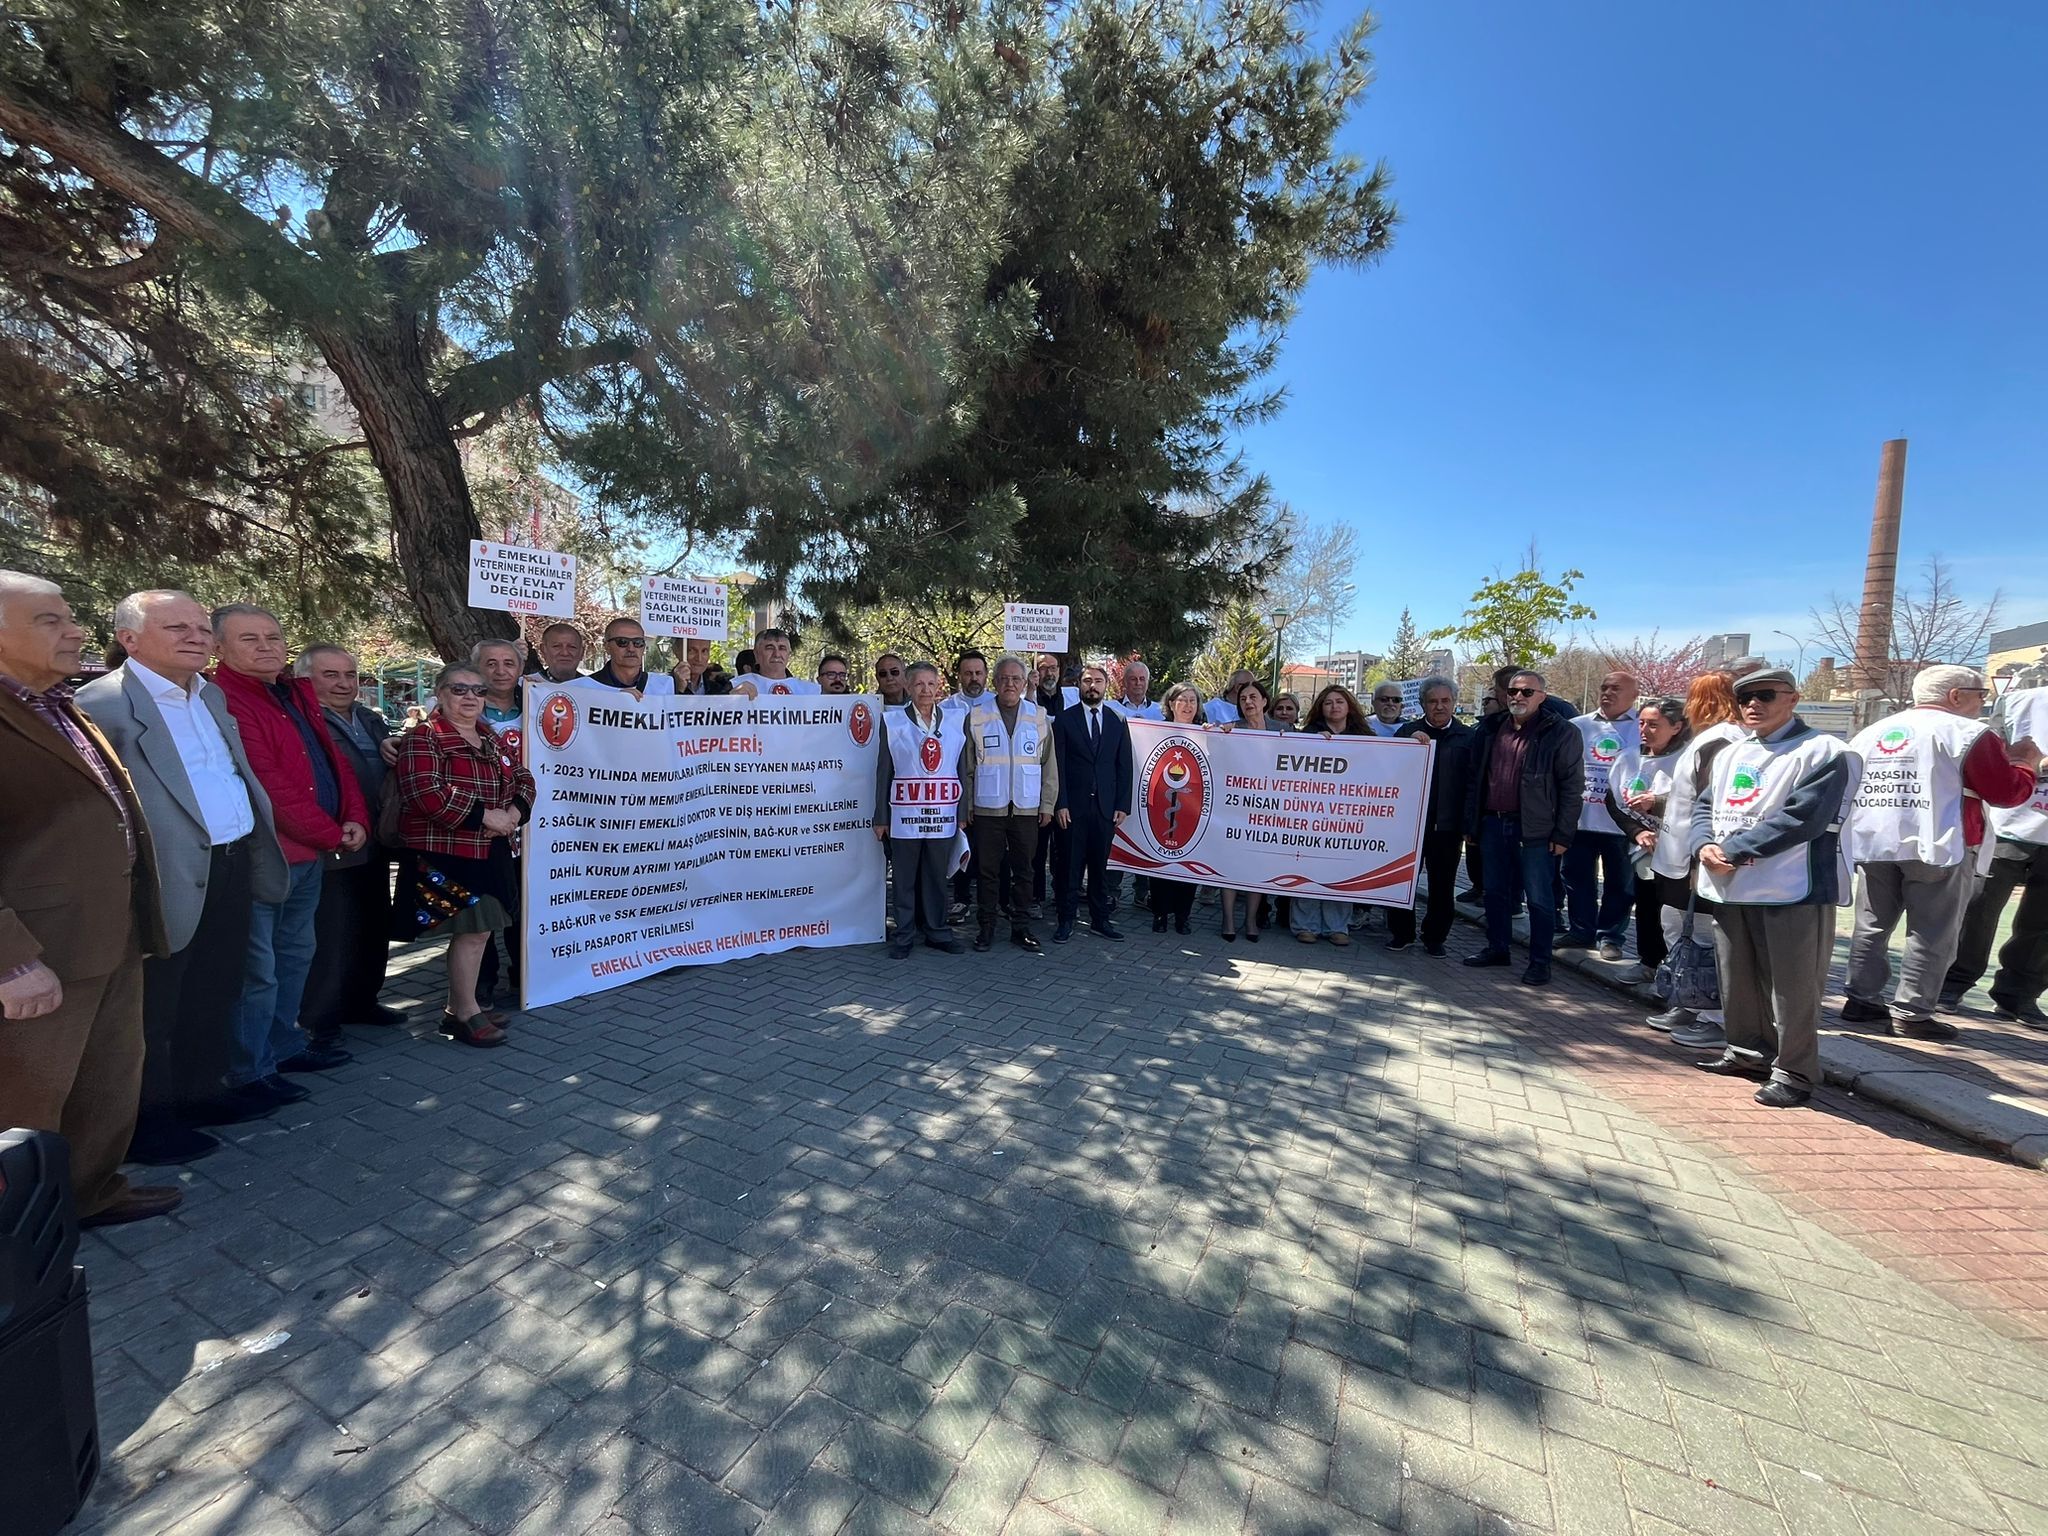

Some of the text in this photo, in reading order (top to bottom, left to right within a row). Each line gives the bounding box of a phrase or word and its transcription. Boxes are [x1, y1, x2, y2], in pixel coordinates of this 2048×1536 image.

[499, 550, 550, 565] EMEKLİ
[474, 558, 572, 580] VETERİNER HEKİMLER
[480, 570, 565, 590] ÜVEY EVLAT
[664, 582, 706, 594] EMEKLİ
[490, 585, 554, 601] DEĞİLDİR
[644, 591, 724, 607] VETERİNER HEKİMLER
[508, 600, 537, 610] EVHED
[646, 602, 724, 617] SAĞLIK SINIFI
[649, 613, 721, 627] EMEKLİSİDİR
[673, 626, 697, 635] EVHED
[588, 707, 664, 730] EMEKLİ
[747, 707, 842, 725] HEKİMLERİN
[677, 734, 762, 757] TALEPLERİ;
[540, 764, 550, 774] 1-
[554, 764, 584, 777] 2023
[588, 769, 637, 781] YILINDA
[734, 762, 788, 772] SEYYANEN
[792, 761, 816, 773] MAAŞ
[817, 759, 843, 772] ARTIŞ
[1276, 754, 1348, 774] EVHED
[1867, 770, 1918, 781] YAŞASIN
[552, 790, 616, 805] ZAMMININ
[620, 795, 646, 806] TÜM
[649, 793, 684, 806] MEMUR
[762, 781, 816, 794] VERİLMESİ,
[896, 783, 960, 800] EVHED
[1226, 775, 1400, 799] EMEKLİ VETERİNER HEKİMLER
[1864, 782, 1921, 794] ÖRGÜTLÜ
[539, 799, 858, 829] 2- SAĞLIK SINIFI EMEKLİSİ DOKTOR VE DİŞ HEKİMİ EMEKLİLERİNE
[1225, 794, 1394, 818] 25 NİSAN DÜNYA VETERİNER
[1249, 813, 1364, 834] HEKİMLER GÜNÜNÜ
[551, 840, 598, 853] ÖDENEN
[602, 843, 618, 853] EK
[623, 839, 664, 853] EMEKLİ
[668, 838, 693, 850] MAAŞ
[754, 826, 798, 838] BAĞ-KUR
[813, 823, 830, 833] SSK
[1226, 828, 1389, 852] BU YILDA BURUK KUTLUYOR.
[550, 841, 844, 879] DAHİL KURUM AYRIMI YAPILMADAN TÜM EMEKLİ VETERİNER
[1158, 846, 1183, 856] EVHED
[550, 879, 688, 906] HEKİMLEREDE ÖDENMESİ,
[539, 886, 814, 935] 3- BAĞ-KUR ve SSK EMEKLİSİ VETERİNER HEKİMLEREDE
[551, 918, 694, 958] YEŞİL PASAPORT VERİLMESİ
[591, 920, 829, 977] EMEKLİ VETERİNER HEKİMLER DERNEĞİ
